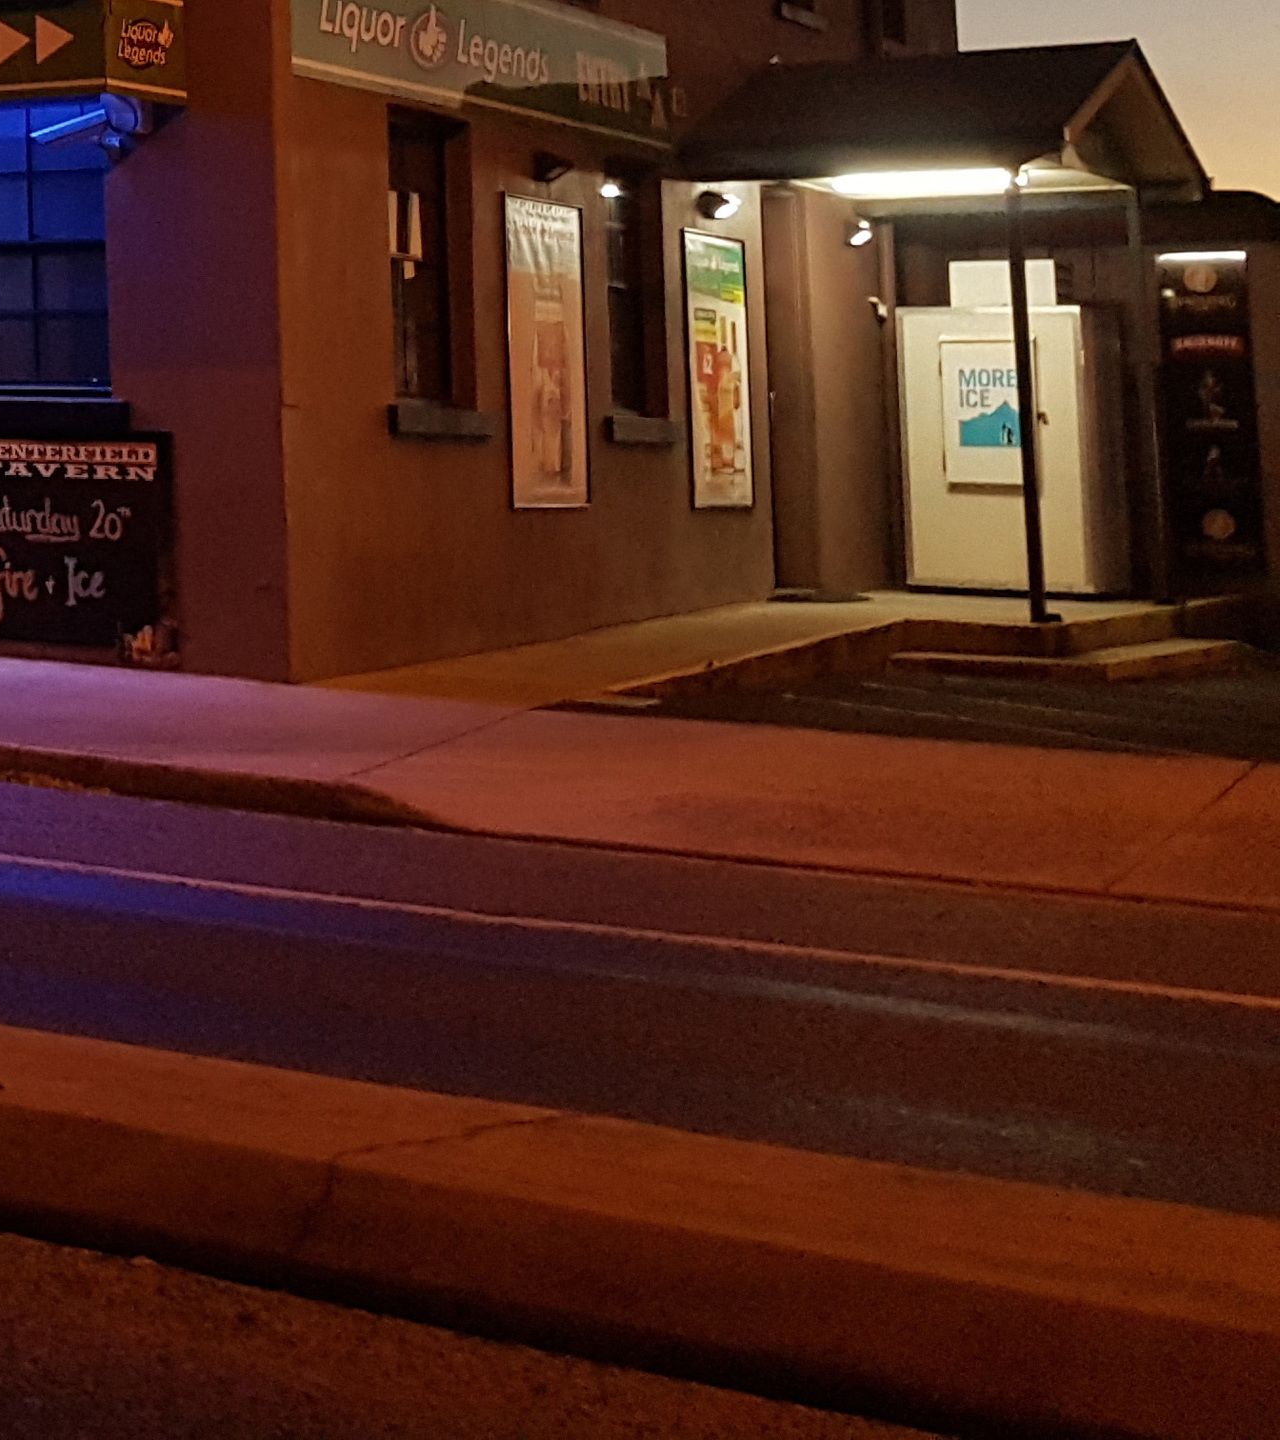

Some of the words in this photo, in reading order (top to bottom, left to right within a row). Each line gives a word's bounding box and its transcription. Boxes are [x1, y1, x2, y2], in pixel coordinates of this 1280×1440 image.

[120, 19, 159, 45] Liquor
[117, 40, 168, 66] Legends
[456, 19, 550, 84] Legends
[958, 368, 1017, 388] MORE
[959, 389, 992, 408] ICE
[64, 556, 105, 606] Ice
